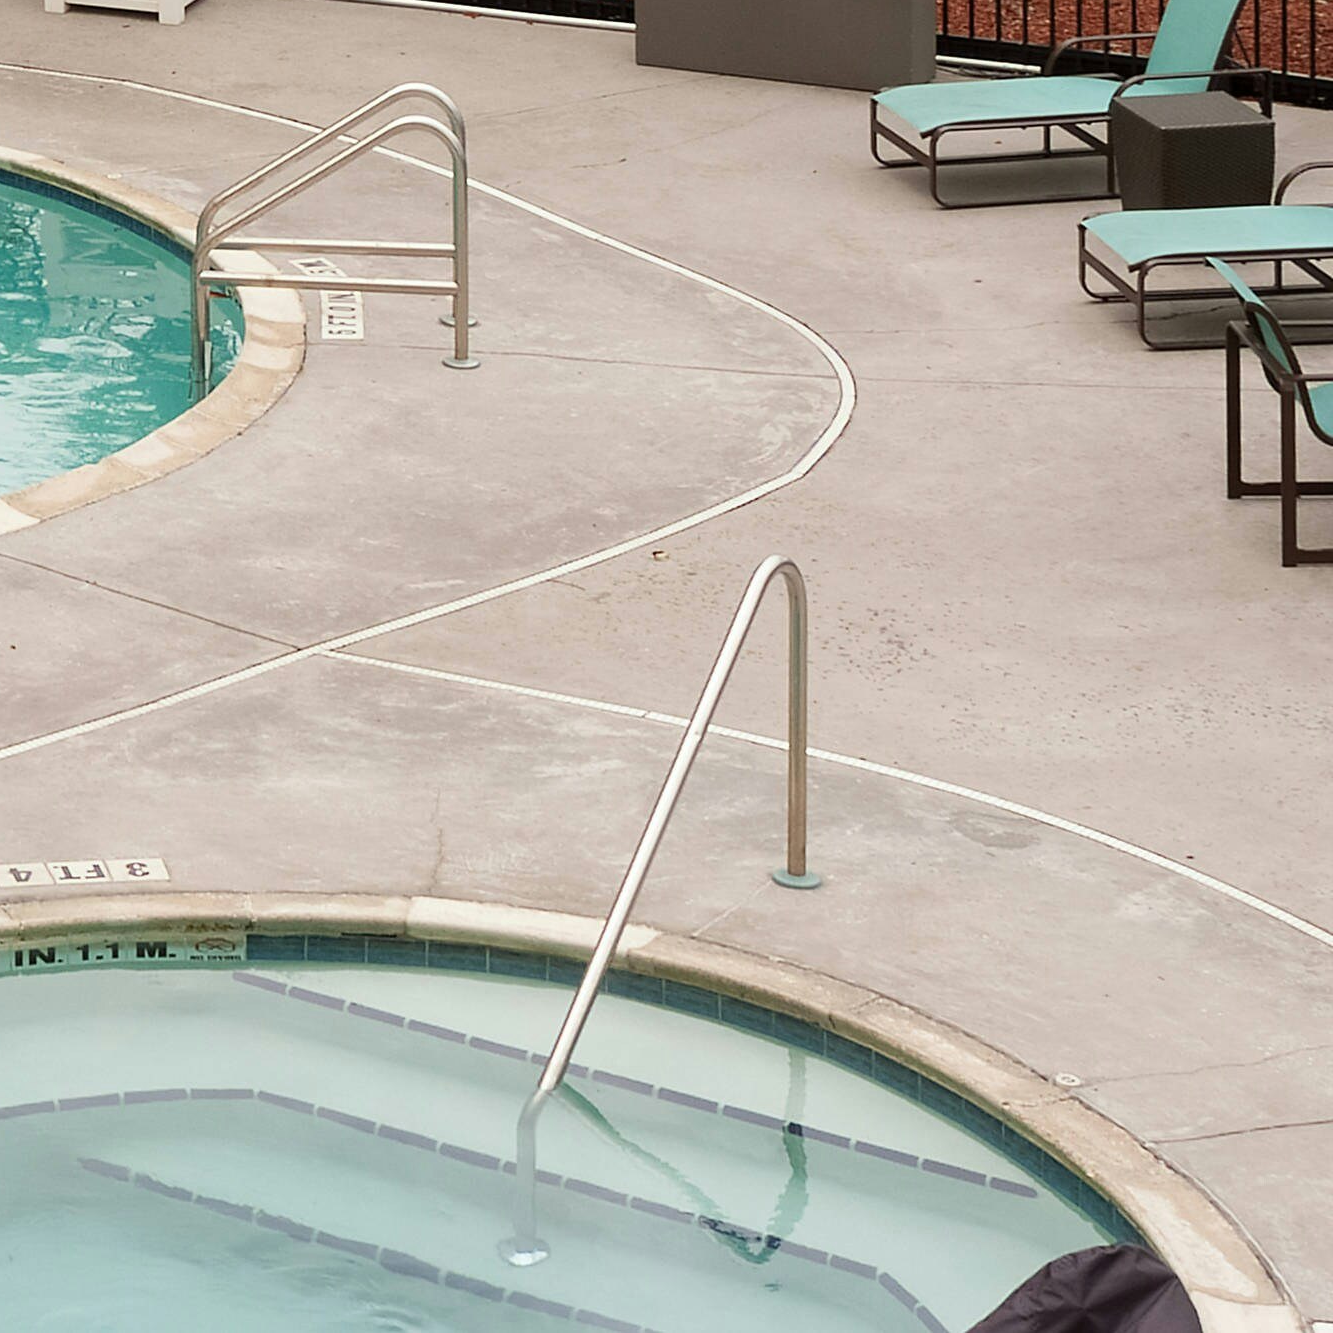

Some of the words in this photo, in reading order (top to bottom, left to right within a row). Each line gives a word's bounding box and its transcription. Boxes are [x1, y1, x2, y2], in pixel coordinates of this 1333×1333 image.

[9, 867, 32, 883] 4
[53, 863, 105, 880] FT.
[126, 862, 149, 877] 3
[15, 947, 63, 967] IN.
[76, 942, 119, 961] 1.1
[136, 941, 176, 958] M.
